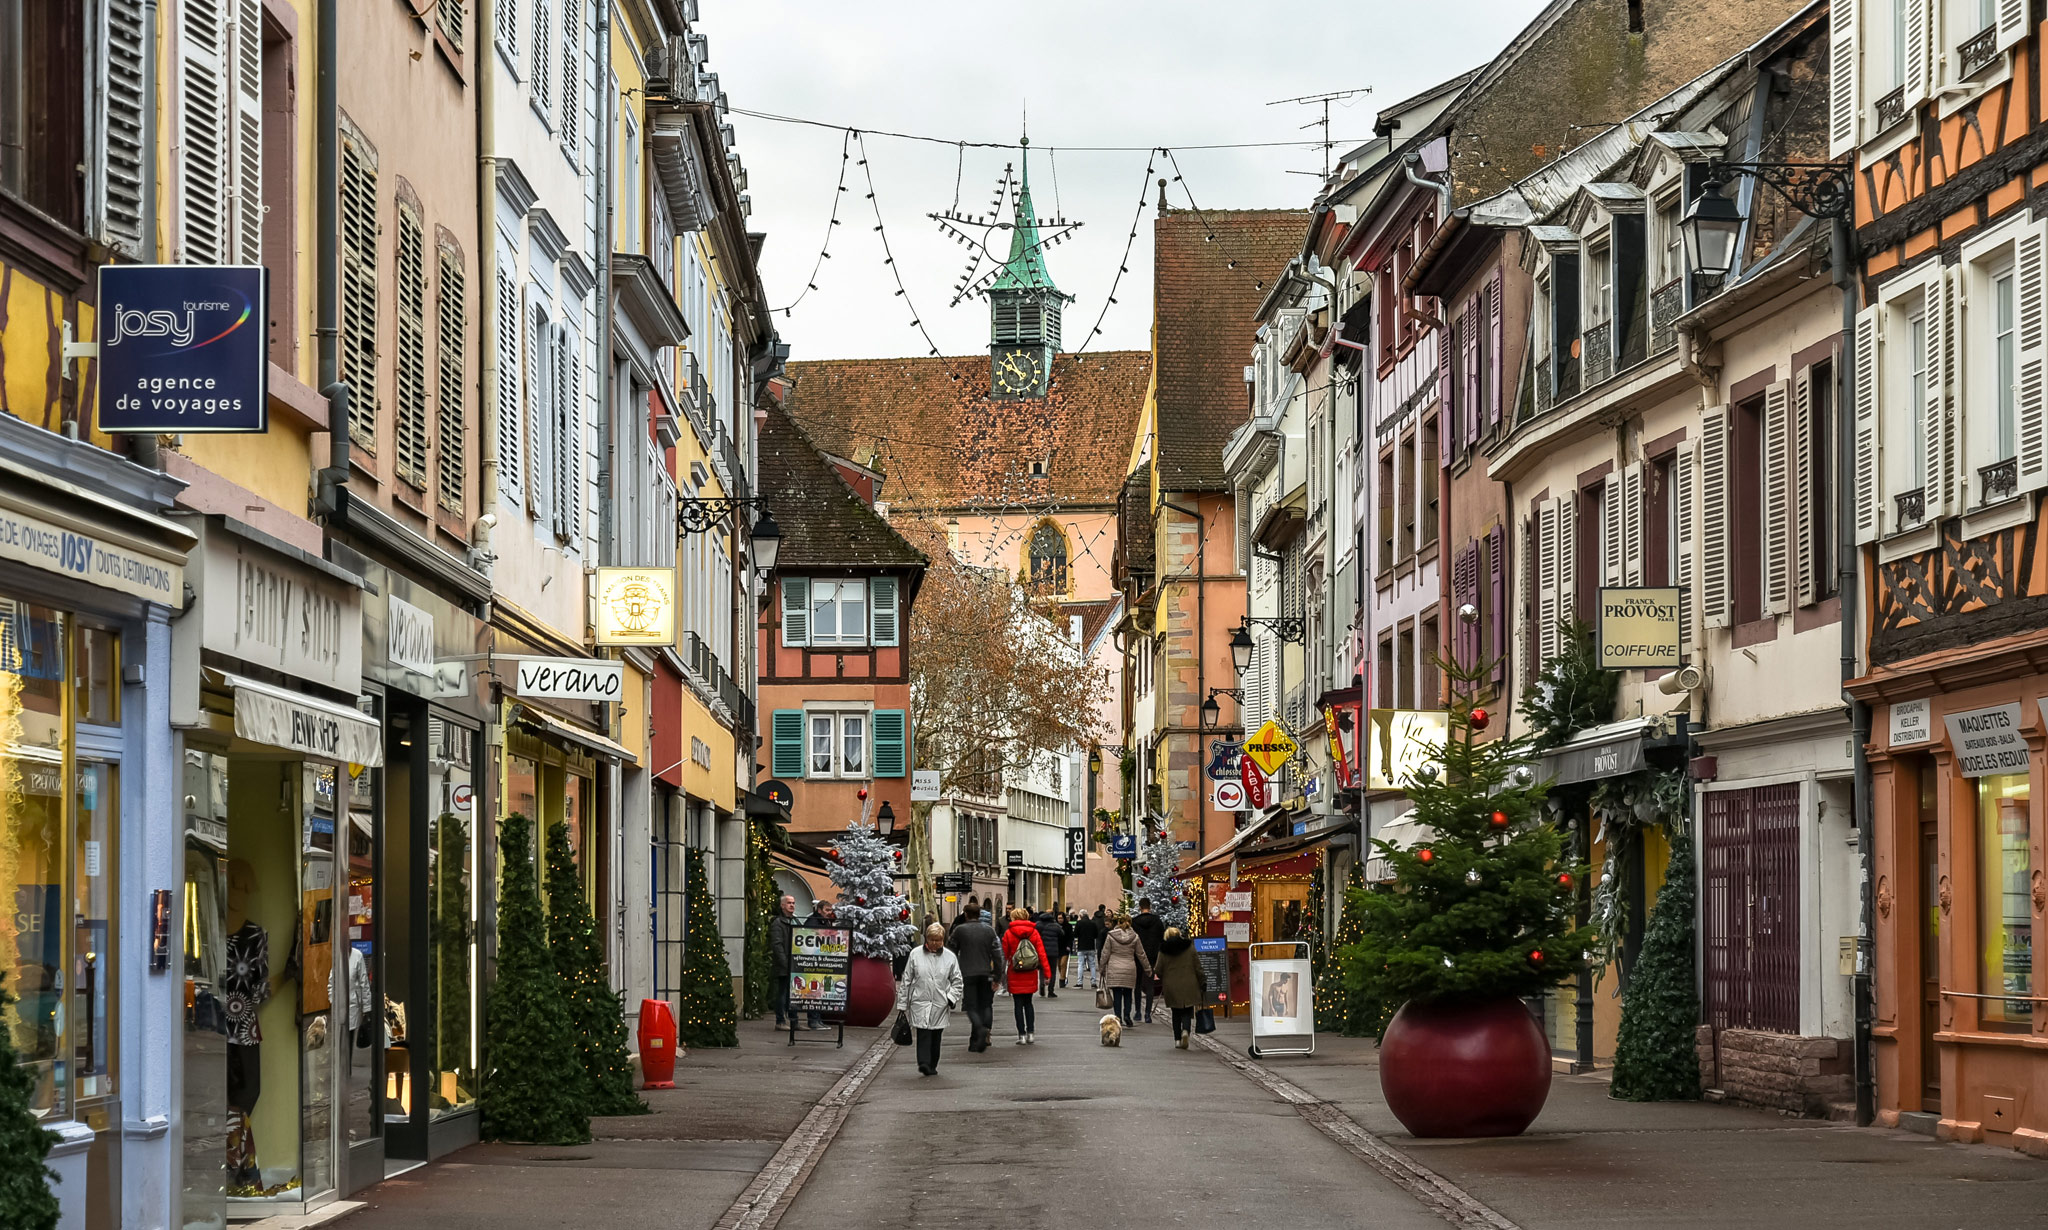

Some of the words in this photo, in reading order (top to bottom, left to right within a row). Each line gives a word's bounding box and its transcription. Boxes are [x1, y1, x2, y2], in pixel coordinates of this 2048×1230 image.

[183, 301, 230, 311] tourisme
[107, 304, 194, 347] josy
[137, 378, 216, 393] agence
[116, 394, 141, 411] de
[151, 399, 242, 415] voyages
[5, 520, 19, 546] DE
[20, 525, 59, 559] VOYAGES
[60, 532, 93, 575] JOSY
[234, 544, 292, 666] jenny
[1604, 605, 1677, 618] PROVOST
[389, 600, 433, 665] verano
[1604, 644, 1677, 657] COIFFURE
[521, 664, 620, 696] verano
[1896, 702, 1924, 716] BROCAPHIL
[1900, 716, 1920, 729] KELLER
[1958, 711, 2011, 734] MAQUETTES
[1893, 729, 1927, 743] DISTRIBUTION
[1964, 737, 1986, 750] BATEAUX
[1986, 735, 1998, 747] BOIS
[2000, 733, 2016, 746] BALSA
[1248, 743, 1292, 753] PRESSE
[1594, 753, 1618, 773] PROVOST
[1957, 752, 1999, 773] MODELES
[2000, 749, 2030, 768] REDUIT
[1245, 761, 1261, 802] TABAC
[1070, 831, 1083, 870] fnac
